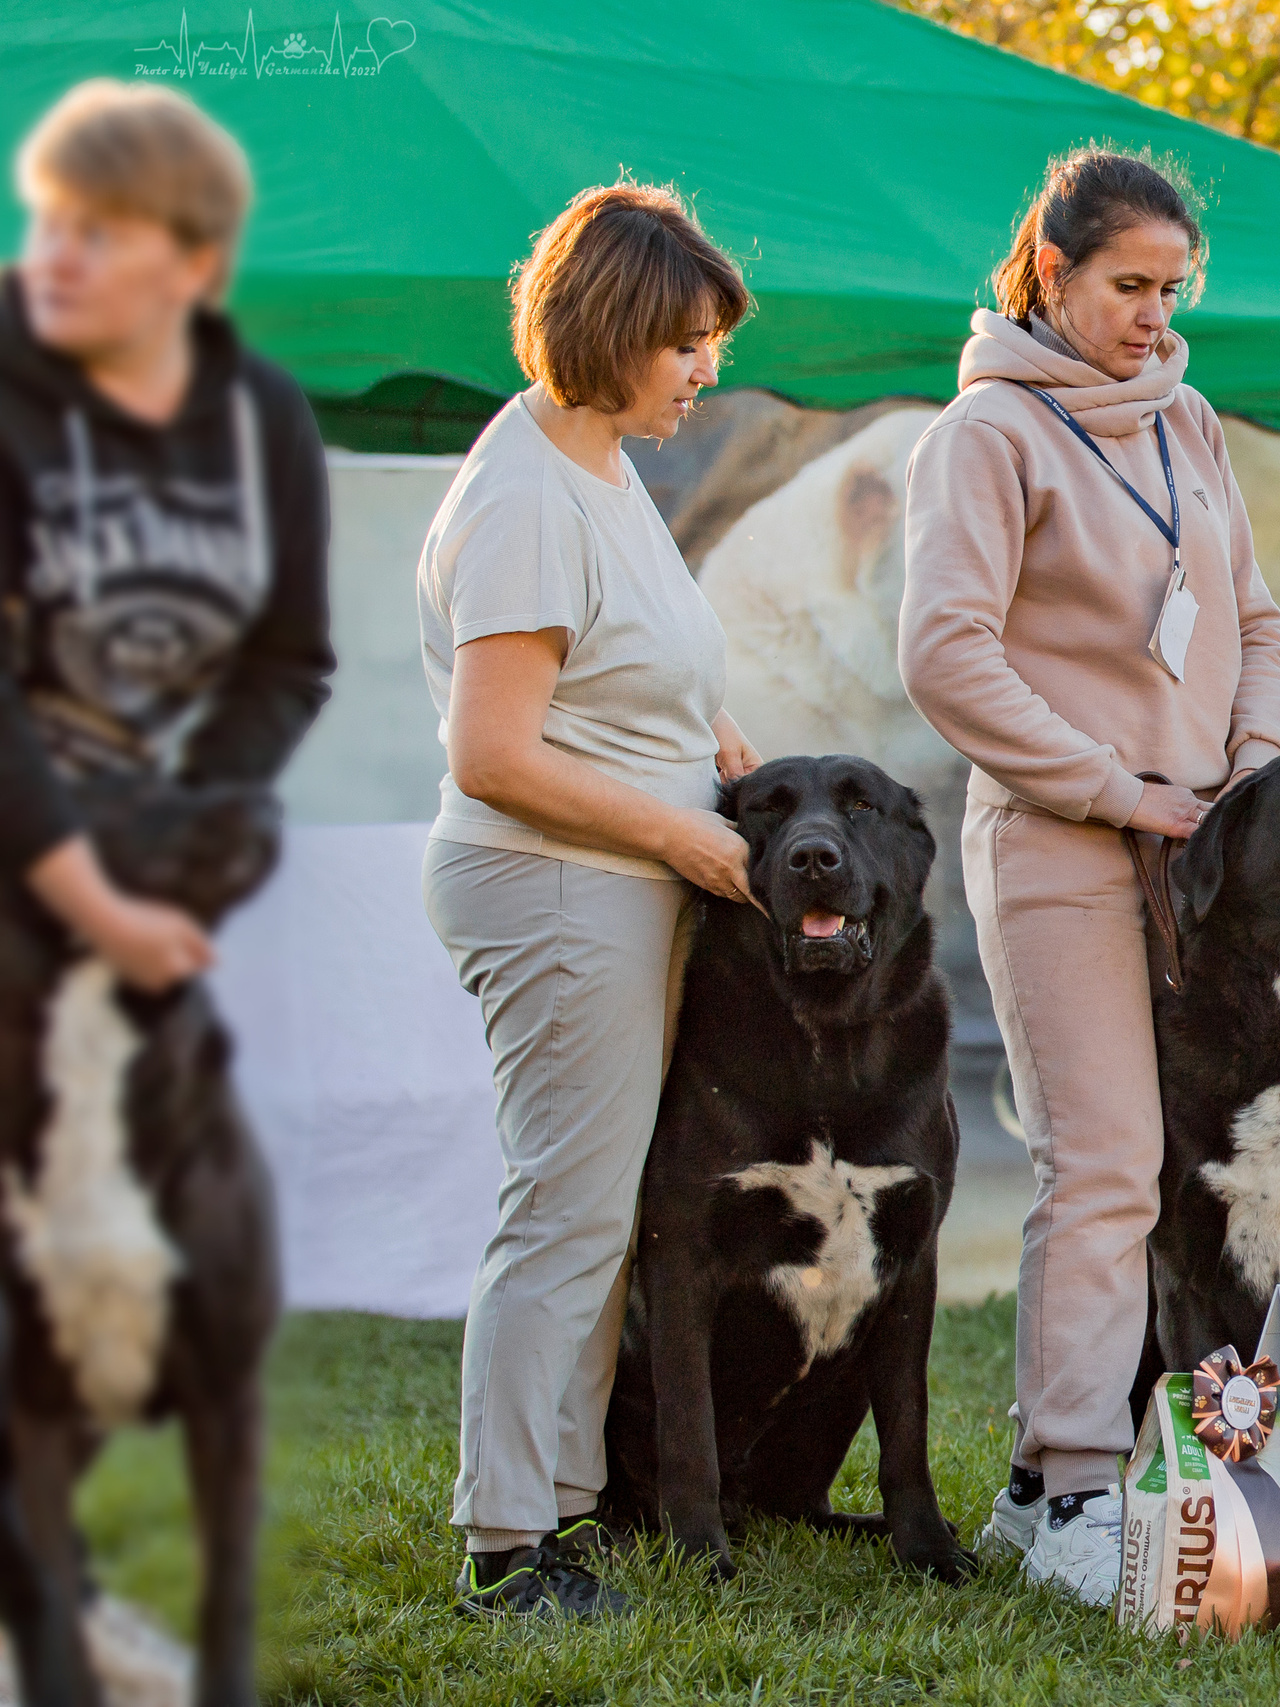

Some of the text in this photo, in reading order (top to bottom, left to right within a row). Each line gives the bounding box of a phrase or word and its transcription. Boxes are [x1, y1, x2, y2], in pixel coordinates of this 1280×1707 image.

[1181, 1444, 1204, 1458] ADULT
[1142, 1520, 1152, 1572] ОВОЩАМИ
[1174, 1496, 1216, 1640] IRIUS
